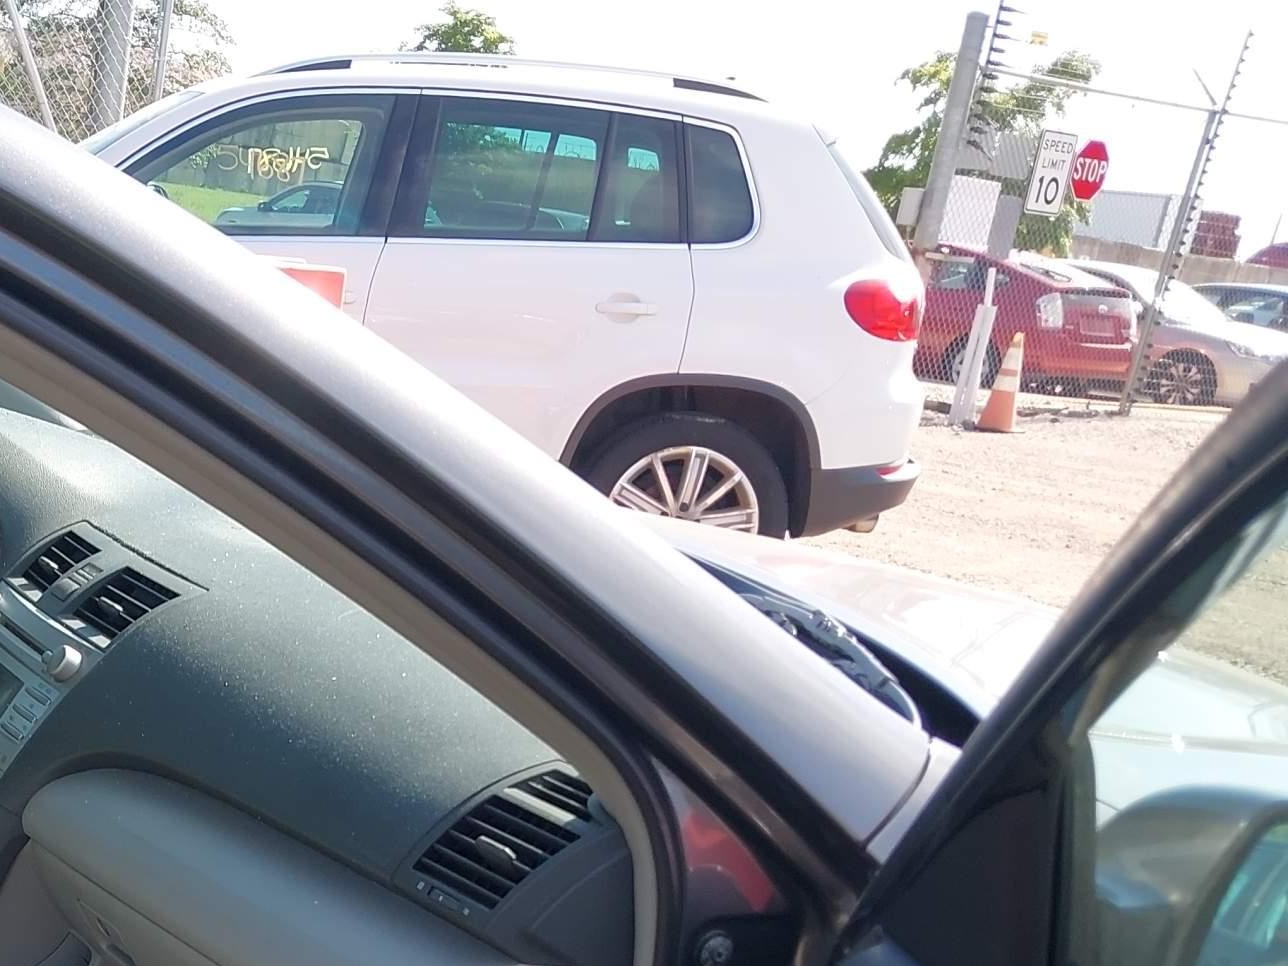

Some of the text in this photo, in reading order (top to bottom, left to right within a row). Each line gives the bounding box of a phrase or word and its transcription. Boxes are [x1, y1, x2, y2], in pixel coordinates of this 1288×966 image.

[1043, 139, 1074, 154] SPEED
[1042, 159, 1066, 171] LIMIT
[1073, 157, 1107, 183] STOP
[1035, 176, 1059, 205] 10
